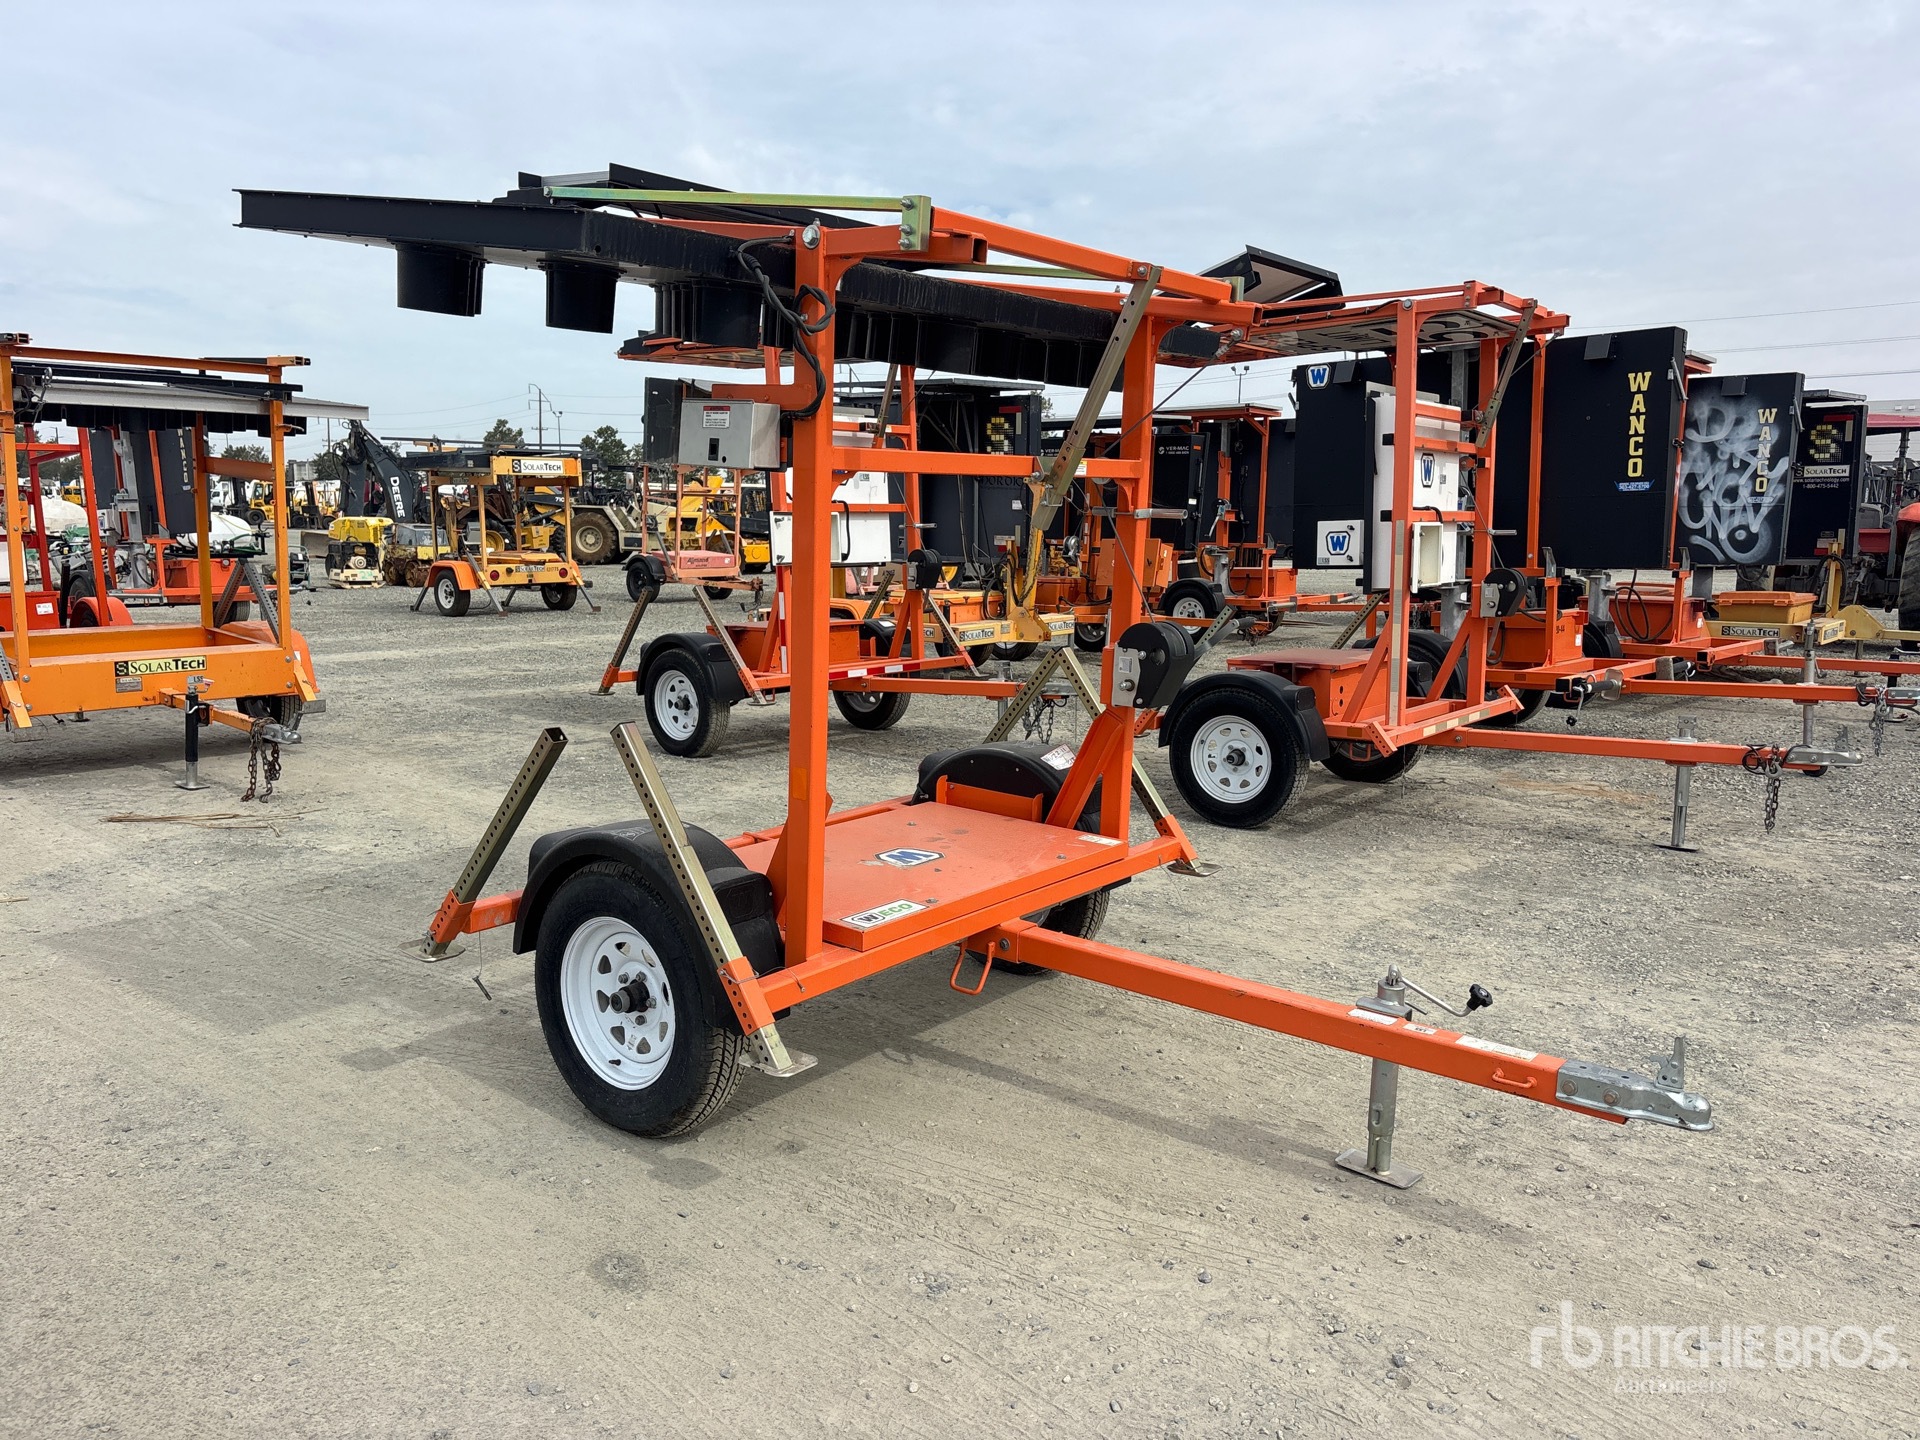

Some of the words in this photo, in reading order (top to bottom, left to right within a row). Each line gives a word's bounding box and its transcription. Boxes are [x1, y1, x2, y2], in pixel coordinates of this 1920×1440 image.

[1628, 371, 1652, 478] WANCO
[176, 428, 189, 483] WANCO
[1755, 408, 1778, 493] WANCO
[523, 462, 562, 472] SOLARTECH
[1805, 467, 1847, 476] SOLARTECH
[390, 476, 406, 518] DEERE
[1731, 627, 1779, 637] SOLARTECH
[130, 658, 206, 674] SOLARTECH
[878, 903, 913, 916] ECO
